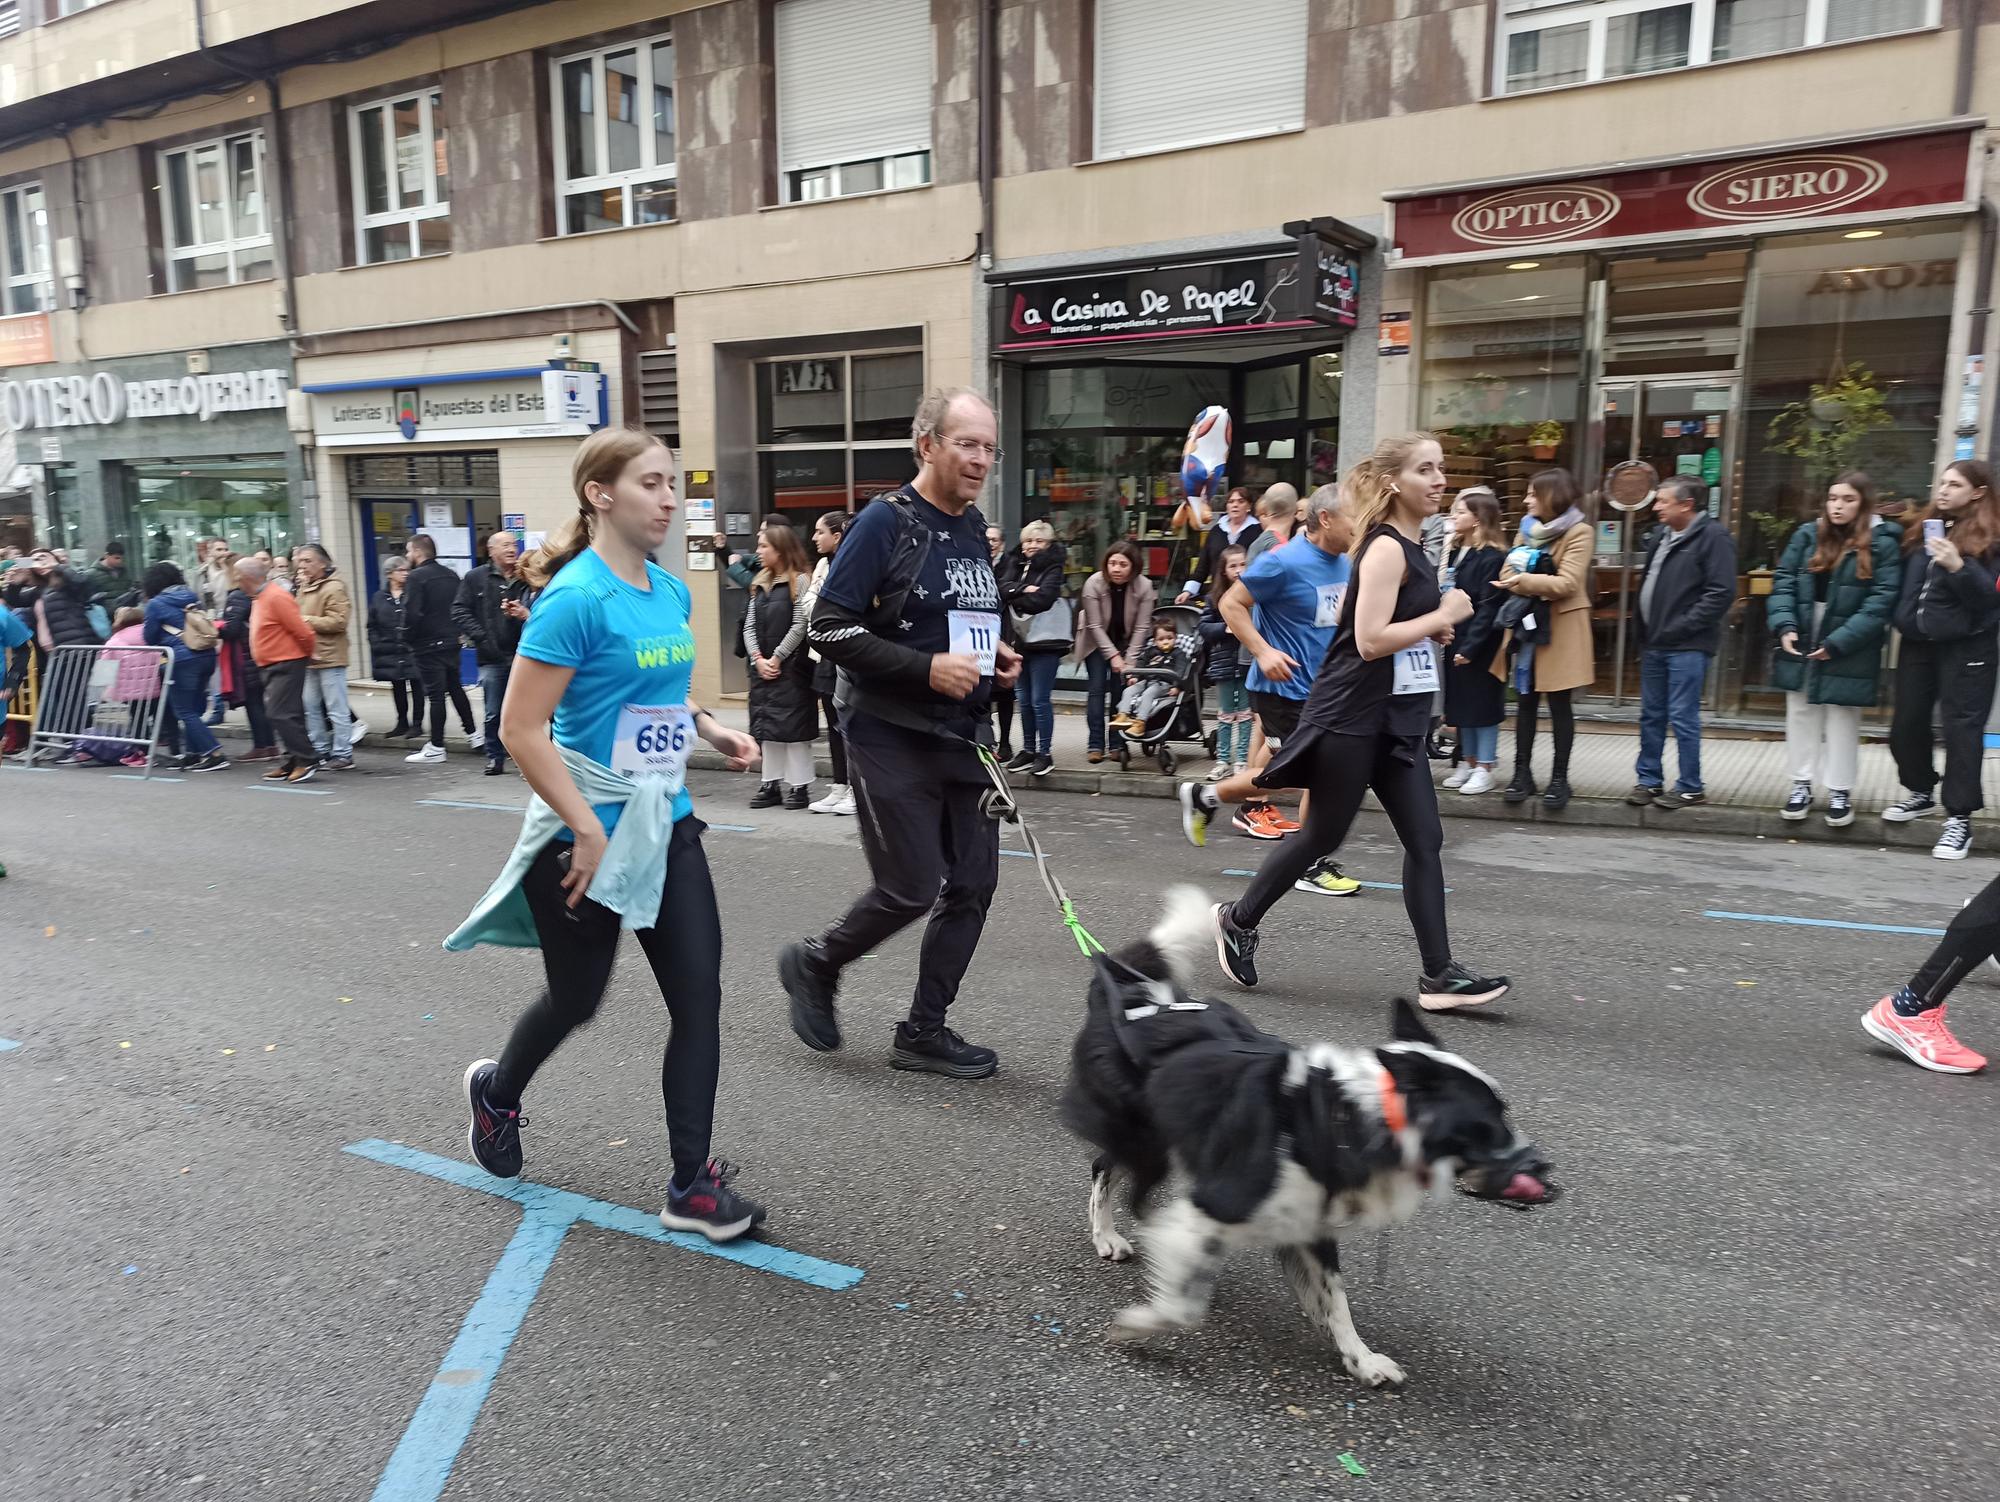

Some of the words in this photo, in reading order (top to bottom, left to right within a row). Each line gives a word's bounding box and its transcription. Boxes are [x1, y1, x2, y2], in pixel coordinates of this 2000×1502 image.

[1726, 166, 1849, 206] SIERO
[1471, 197, 1594, 232] OPTICA
[1010, 293, 1050, 334] La
[1051, 292, 1129, 322] Casina
[1139, 289, 1171, 317] De
[1182, 279, 1257, 324] Papel
[5, 372, 126, 431] OTERO
[126, 368, 288, 422] RELOJERIA
[332, 402, 382, 423] Loterías
[384, 406, 394, 423] y
[423, 398, 484, 422] Apuestas
[490, 394, 511, 413] del
[516, 393, 545, 411] Esta
[969, 627, 992, 651] 111
[635, 648, 669, 669] WE
[1407, 649, 1433, 672] 112
[636, 723, 685, 754] 686
